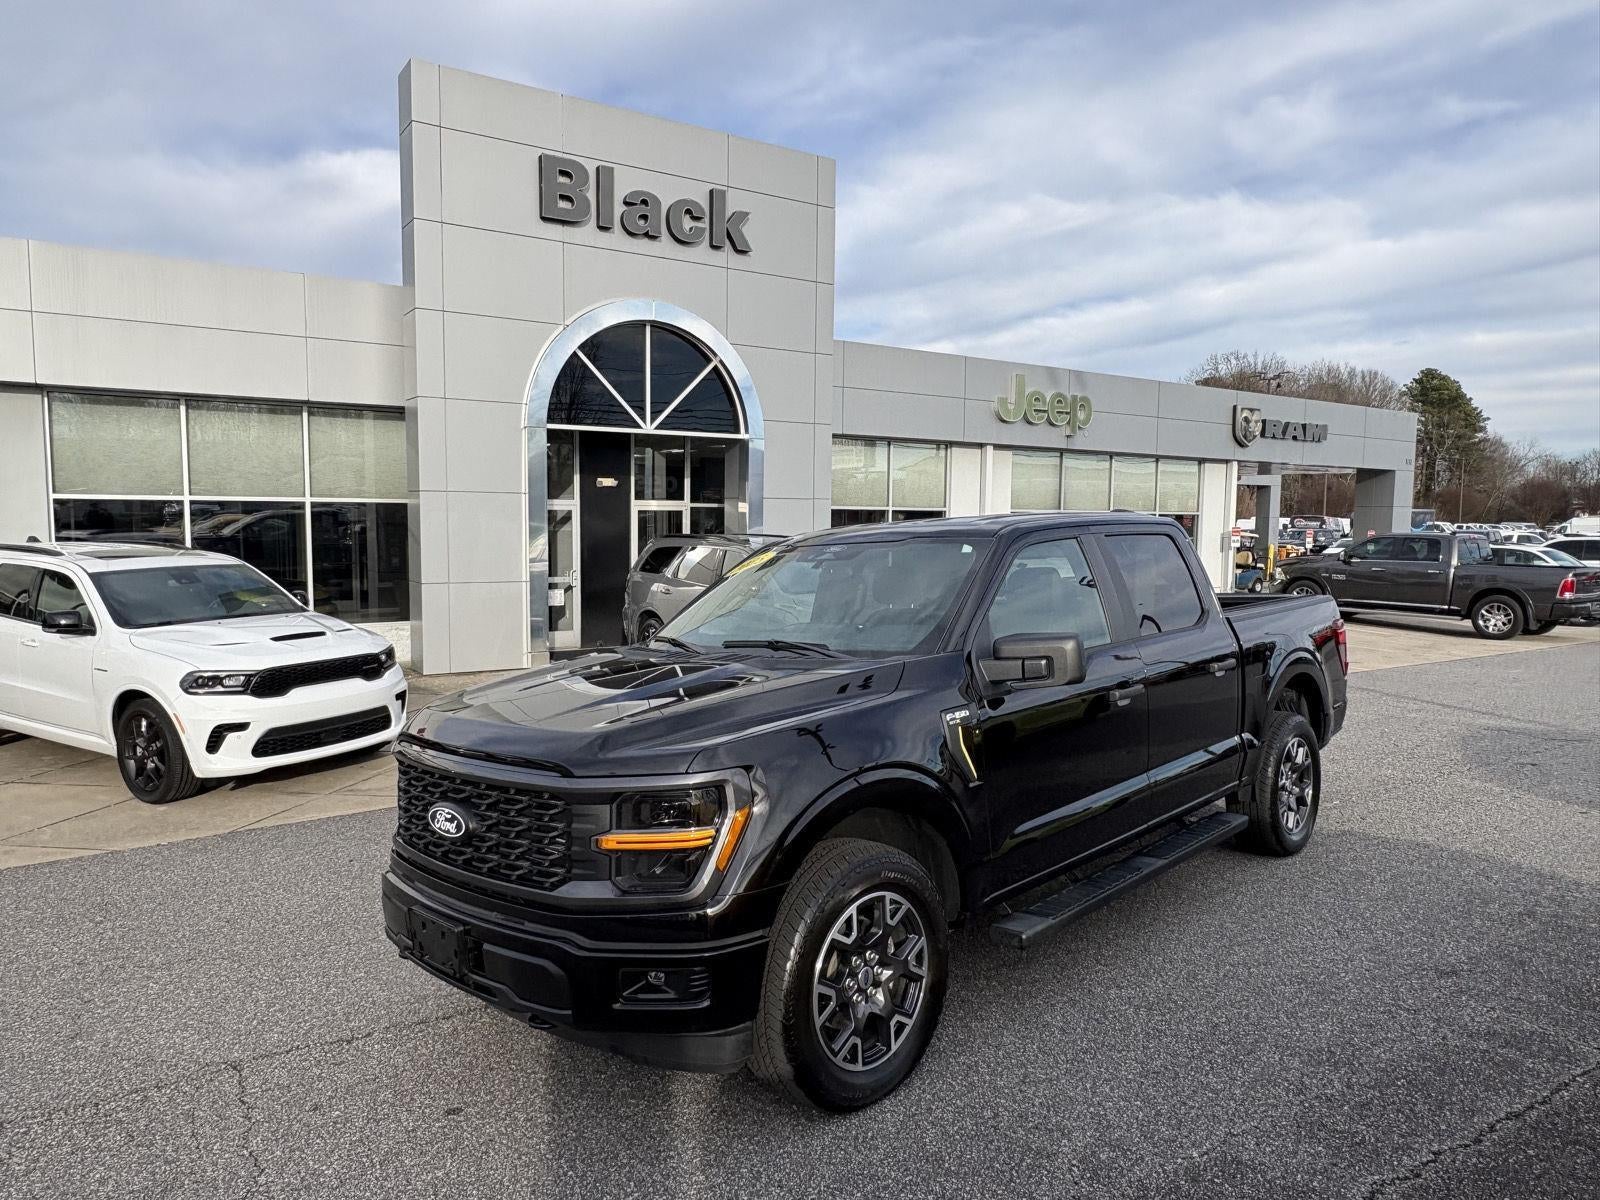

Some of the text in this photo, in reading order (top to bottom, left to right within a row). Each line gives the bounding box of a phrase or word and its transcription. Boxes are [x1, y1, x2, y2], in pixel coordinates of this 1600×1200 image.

[538, 152, 753, 254] Black
[996, 373, 1092, 436] Jeep
[1261, 419, 1328, 442] RAM
[434, 810, 458, 833] Ford
